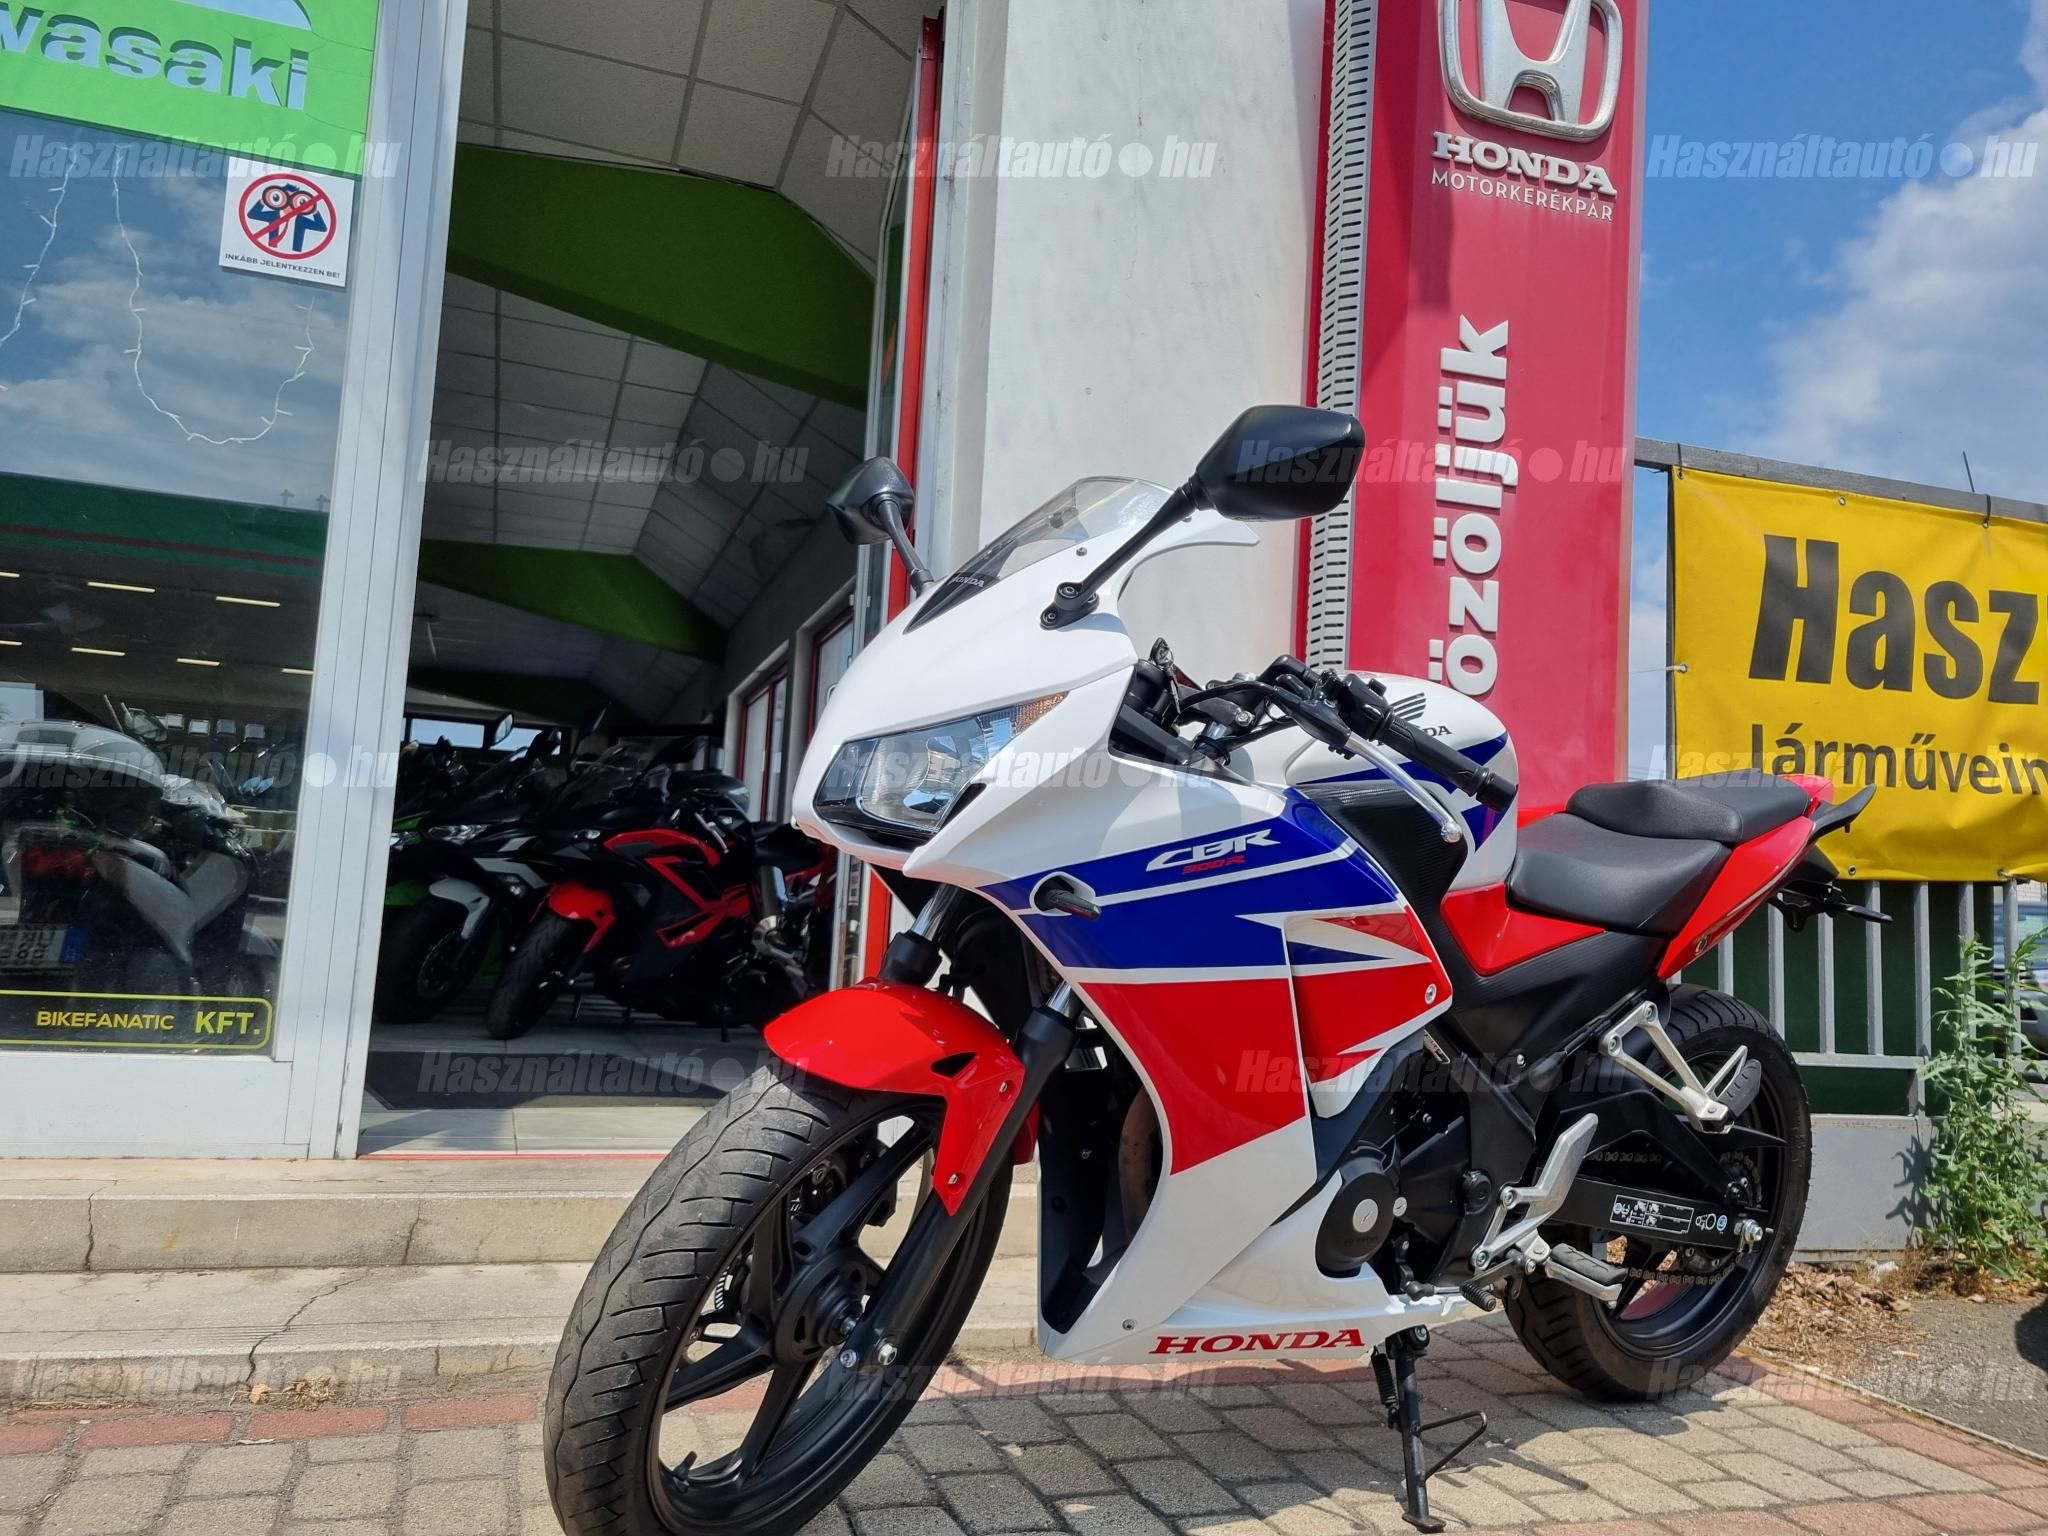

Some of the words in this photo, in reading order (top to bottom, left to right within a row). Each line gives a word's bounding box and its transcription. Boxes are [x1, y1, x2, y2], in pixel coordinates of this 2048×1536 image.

[1432, 131, 1618, 198] HONDA
[1432, 168, 1613, 222] MOTORKERÉKPÁR
[259, 258, 325, 276] JELENTKEZZEN
[1749, 534, 2048, 705] Hasz
[1146, 829, 1281, 873] CBR
[36, 1011, 175, 1031] BIKEFANATIC
[195, 1011, 261, 1035] KFT.
[1149, 1328, 1366, 1355] HONDA
